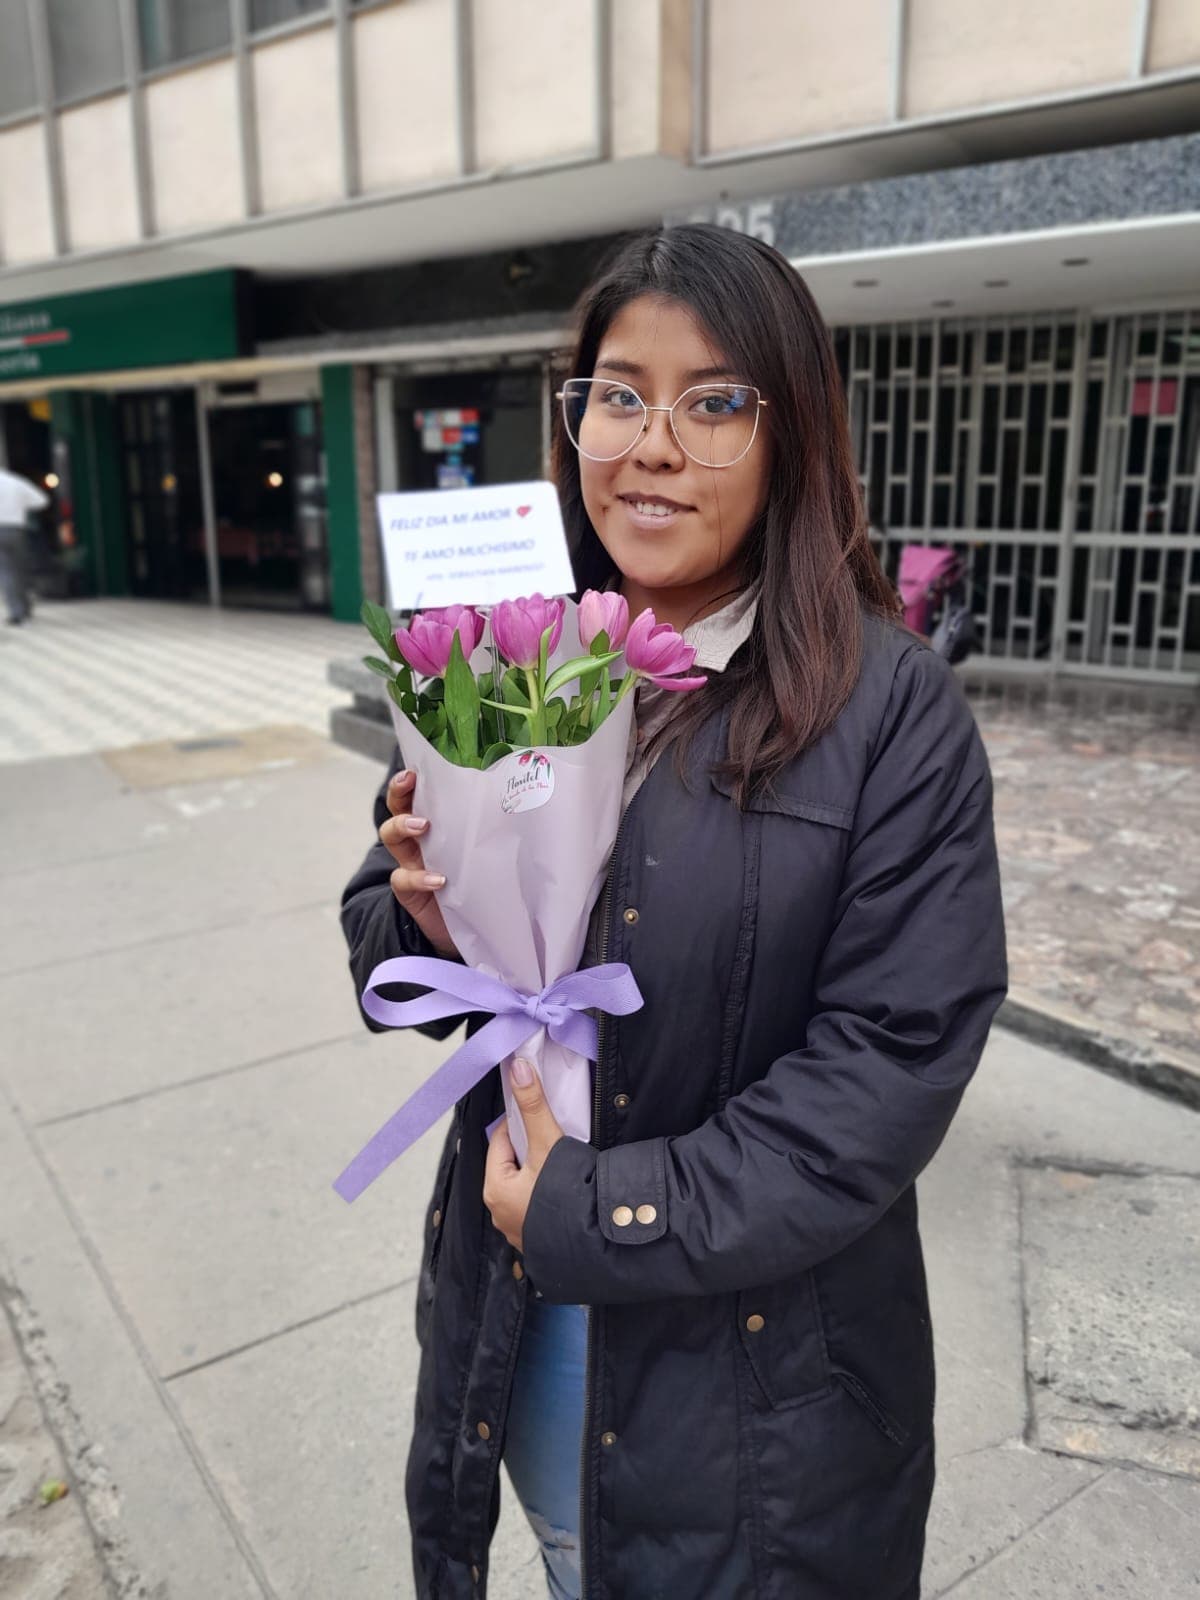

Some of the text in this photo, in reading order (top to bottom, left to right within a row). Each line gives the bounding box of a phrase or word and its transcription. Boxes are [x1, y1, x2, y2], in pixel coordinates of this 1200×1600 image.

[390, 517, 423, 531] FELIZ
[426, 515, 448, 528] DIA
[472, 507, 512, 522] AMOR
[404, 538, 536, 562] TE AMO MUCHISIMO
